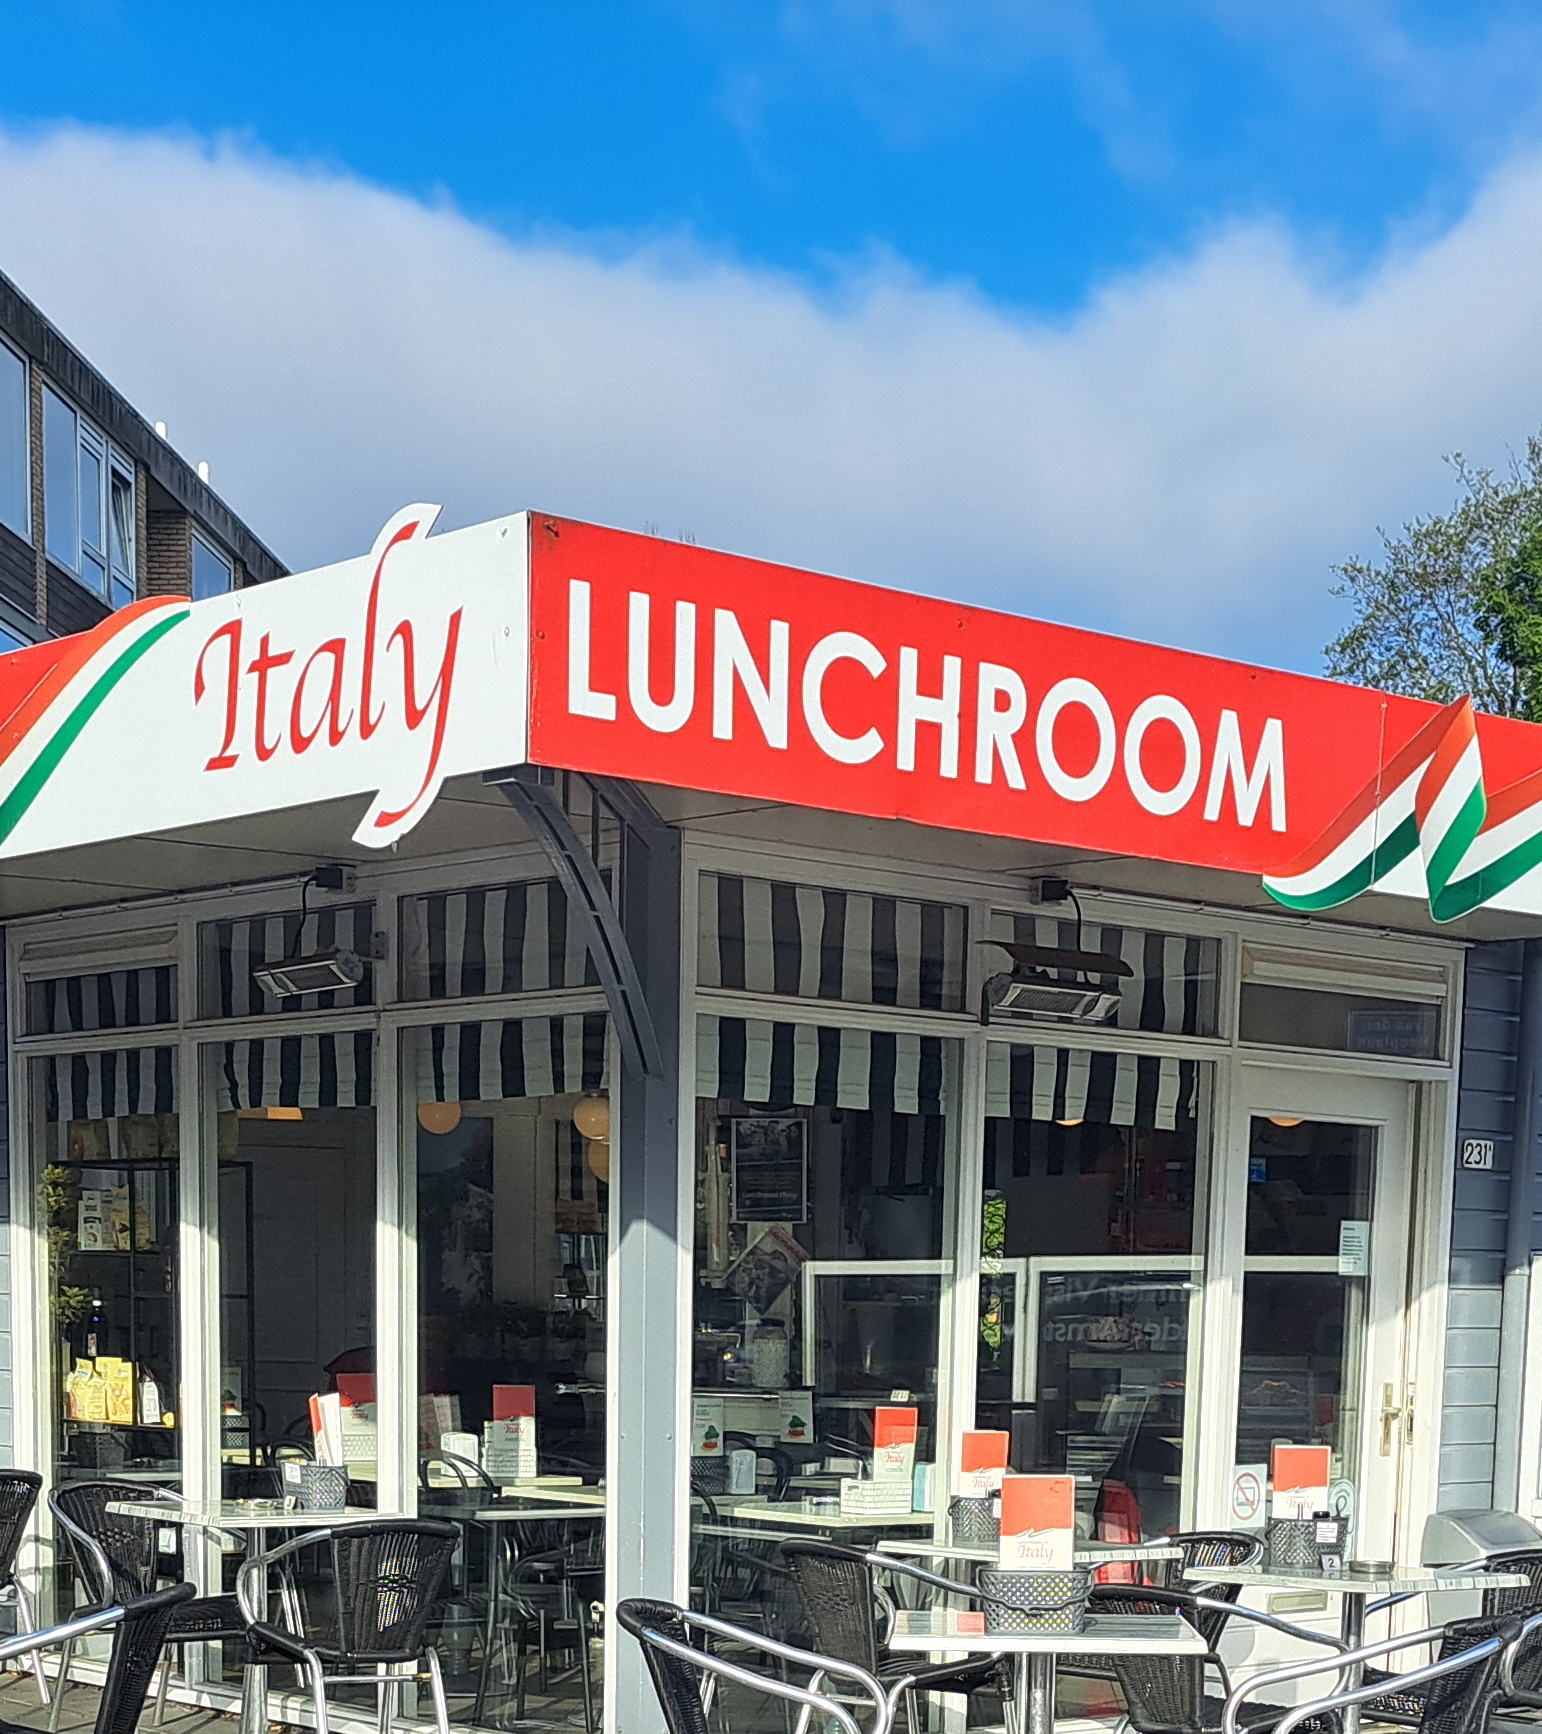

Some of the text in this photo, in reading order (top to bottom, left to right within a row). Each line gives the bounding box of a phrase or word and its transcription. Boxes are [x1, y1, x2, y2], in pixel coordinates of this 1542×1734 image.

[194, 519, 464, 829] Italy
[568, 578, 1287, 833] LUNCHROOM
[1017, 1541, 1054, 1565] Italy
[1327, 1557, 1336, 1568] 2
